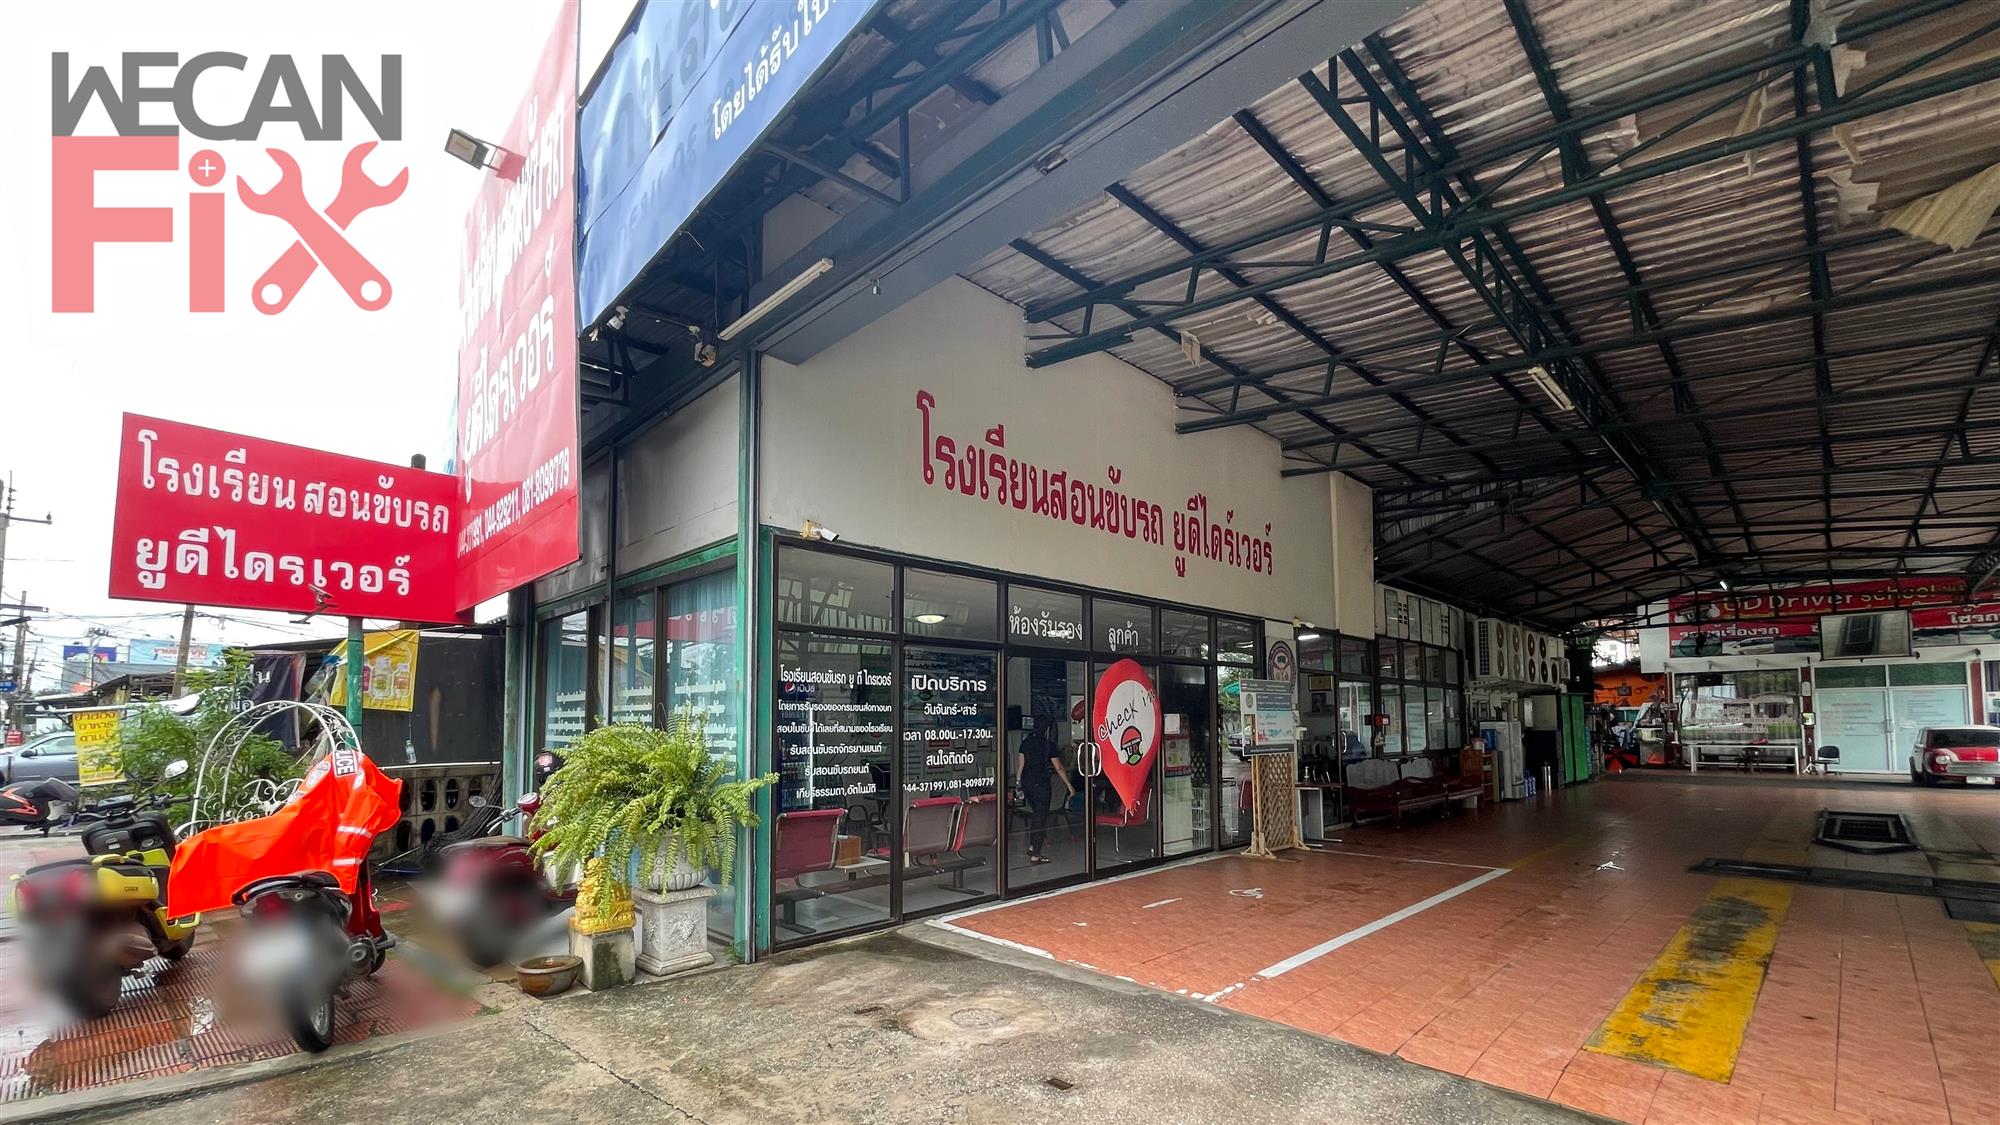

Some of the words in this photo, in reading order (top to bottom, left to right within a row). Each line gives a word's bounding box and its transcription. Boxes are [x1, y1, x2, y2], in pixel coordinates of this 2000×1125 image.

[712, 0, 836, 140] โดยได้รับใบ
[138, 429, 296, 510] โรงเรียน
[303, 474, 450, 534] สอนขับรถ
[916, 389, 1165, 546] โรงเรียนสอนขับรถ
[1108, 620, 1139, 652] ลูกค้า
[780, 664, 847, 685] โรงเรียนสอนขับรถ
[911, 674, 987, 692] เปิดบริการ
[926, 749, 974, 766] สนใจติดต่อ
